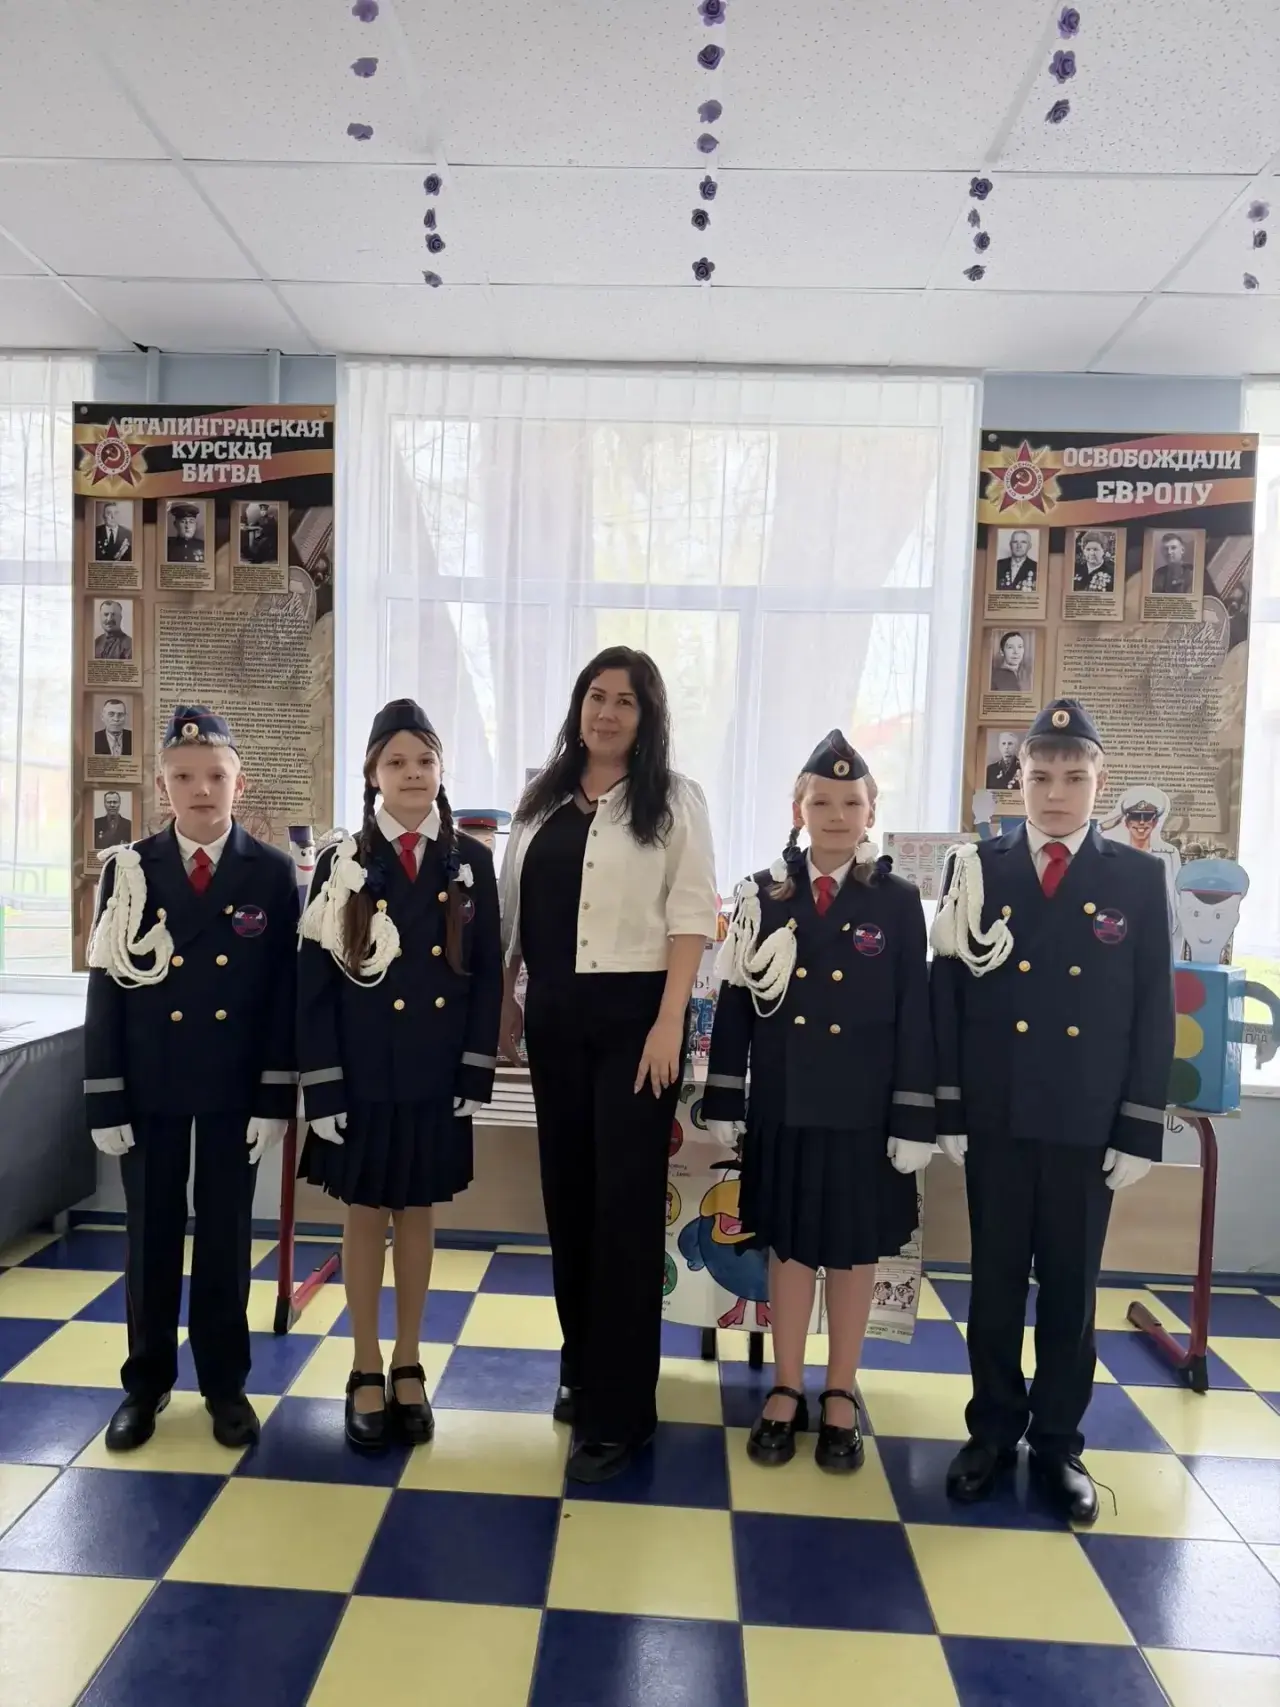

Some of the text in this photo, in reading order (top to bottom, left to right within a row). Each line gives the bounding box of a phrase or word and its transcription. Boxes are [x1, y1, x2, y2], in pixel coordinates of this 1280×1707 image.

[120, 416, 325, 438] СТАЛИНГРАДСКАЯ
[171, 441, 272, 460] КУРСКАЯ
[1063, 447, 1242, 470] ОСВОБОЖДАЛИ
[182, 464, 262, 483] БИТВА
[1096, 480, 1213, 505] ЕВРОПУ
